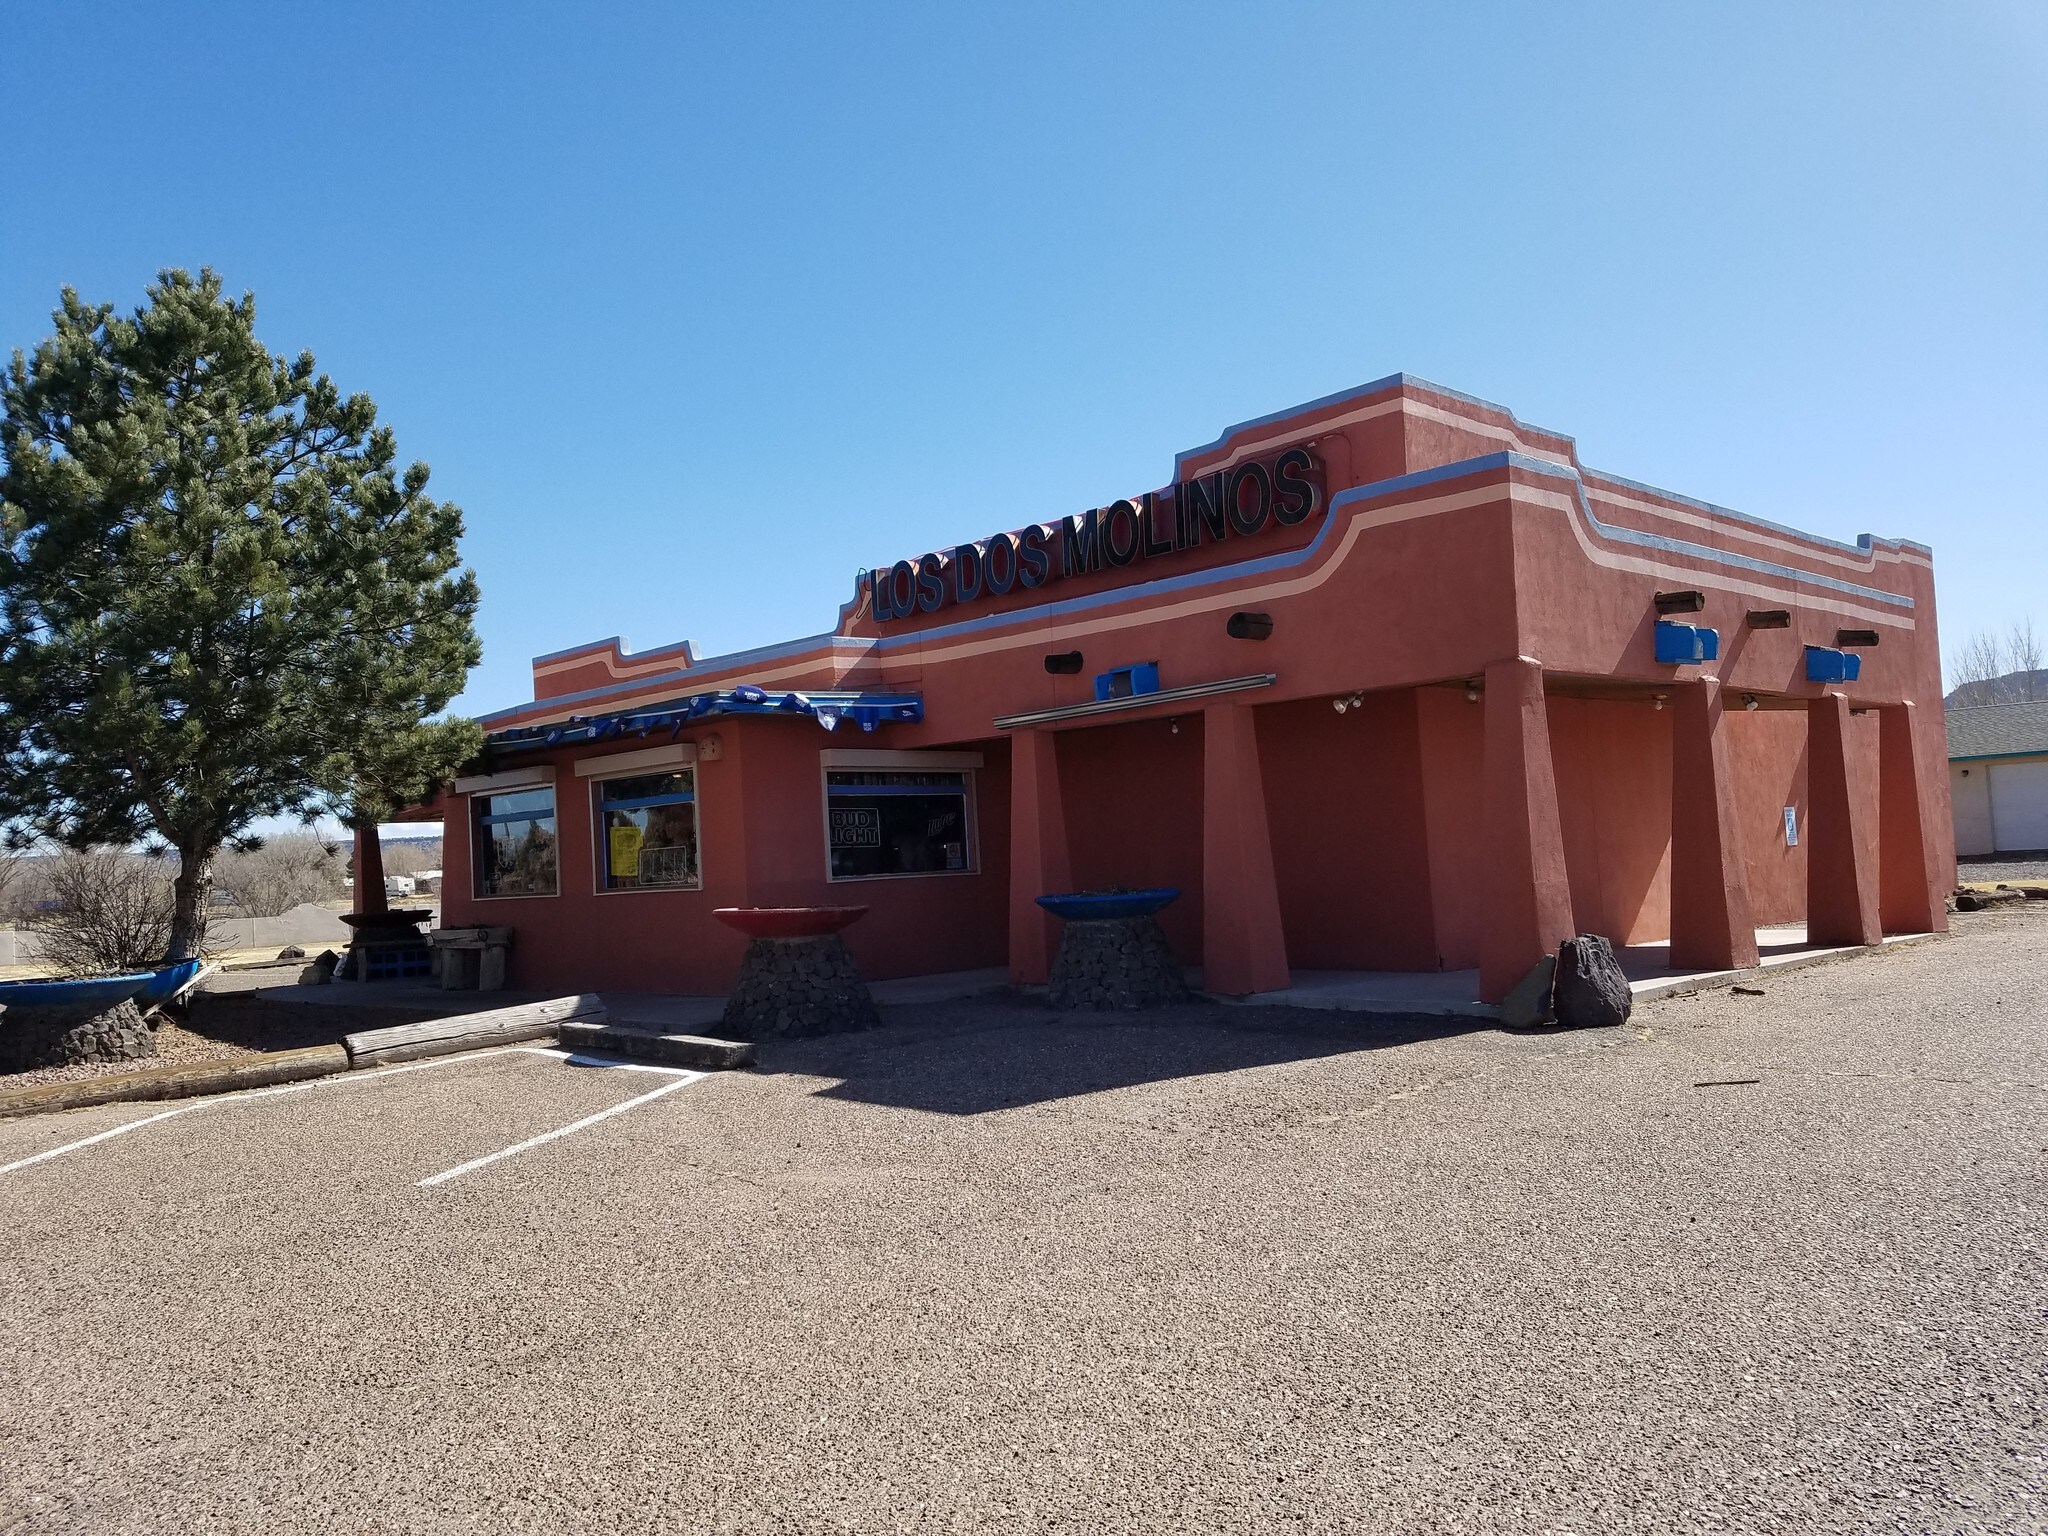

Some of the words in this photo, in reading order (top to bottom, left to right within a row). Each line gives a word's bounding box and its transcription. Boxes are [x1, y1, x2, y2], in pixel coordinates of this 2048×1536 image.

[871, 552, 945, 622] LOS
[954, 524, 1049, 602] DOS
[1062, 448, 1316, 578] MOLINOS
[832, 811, 870, 827] BUD
